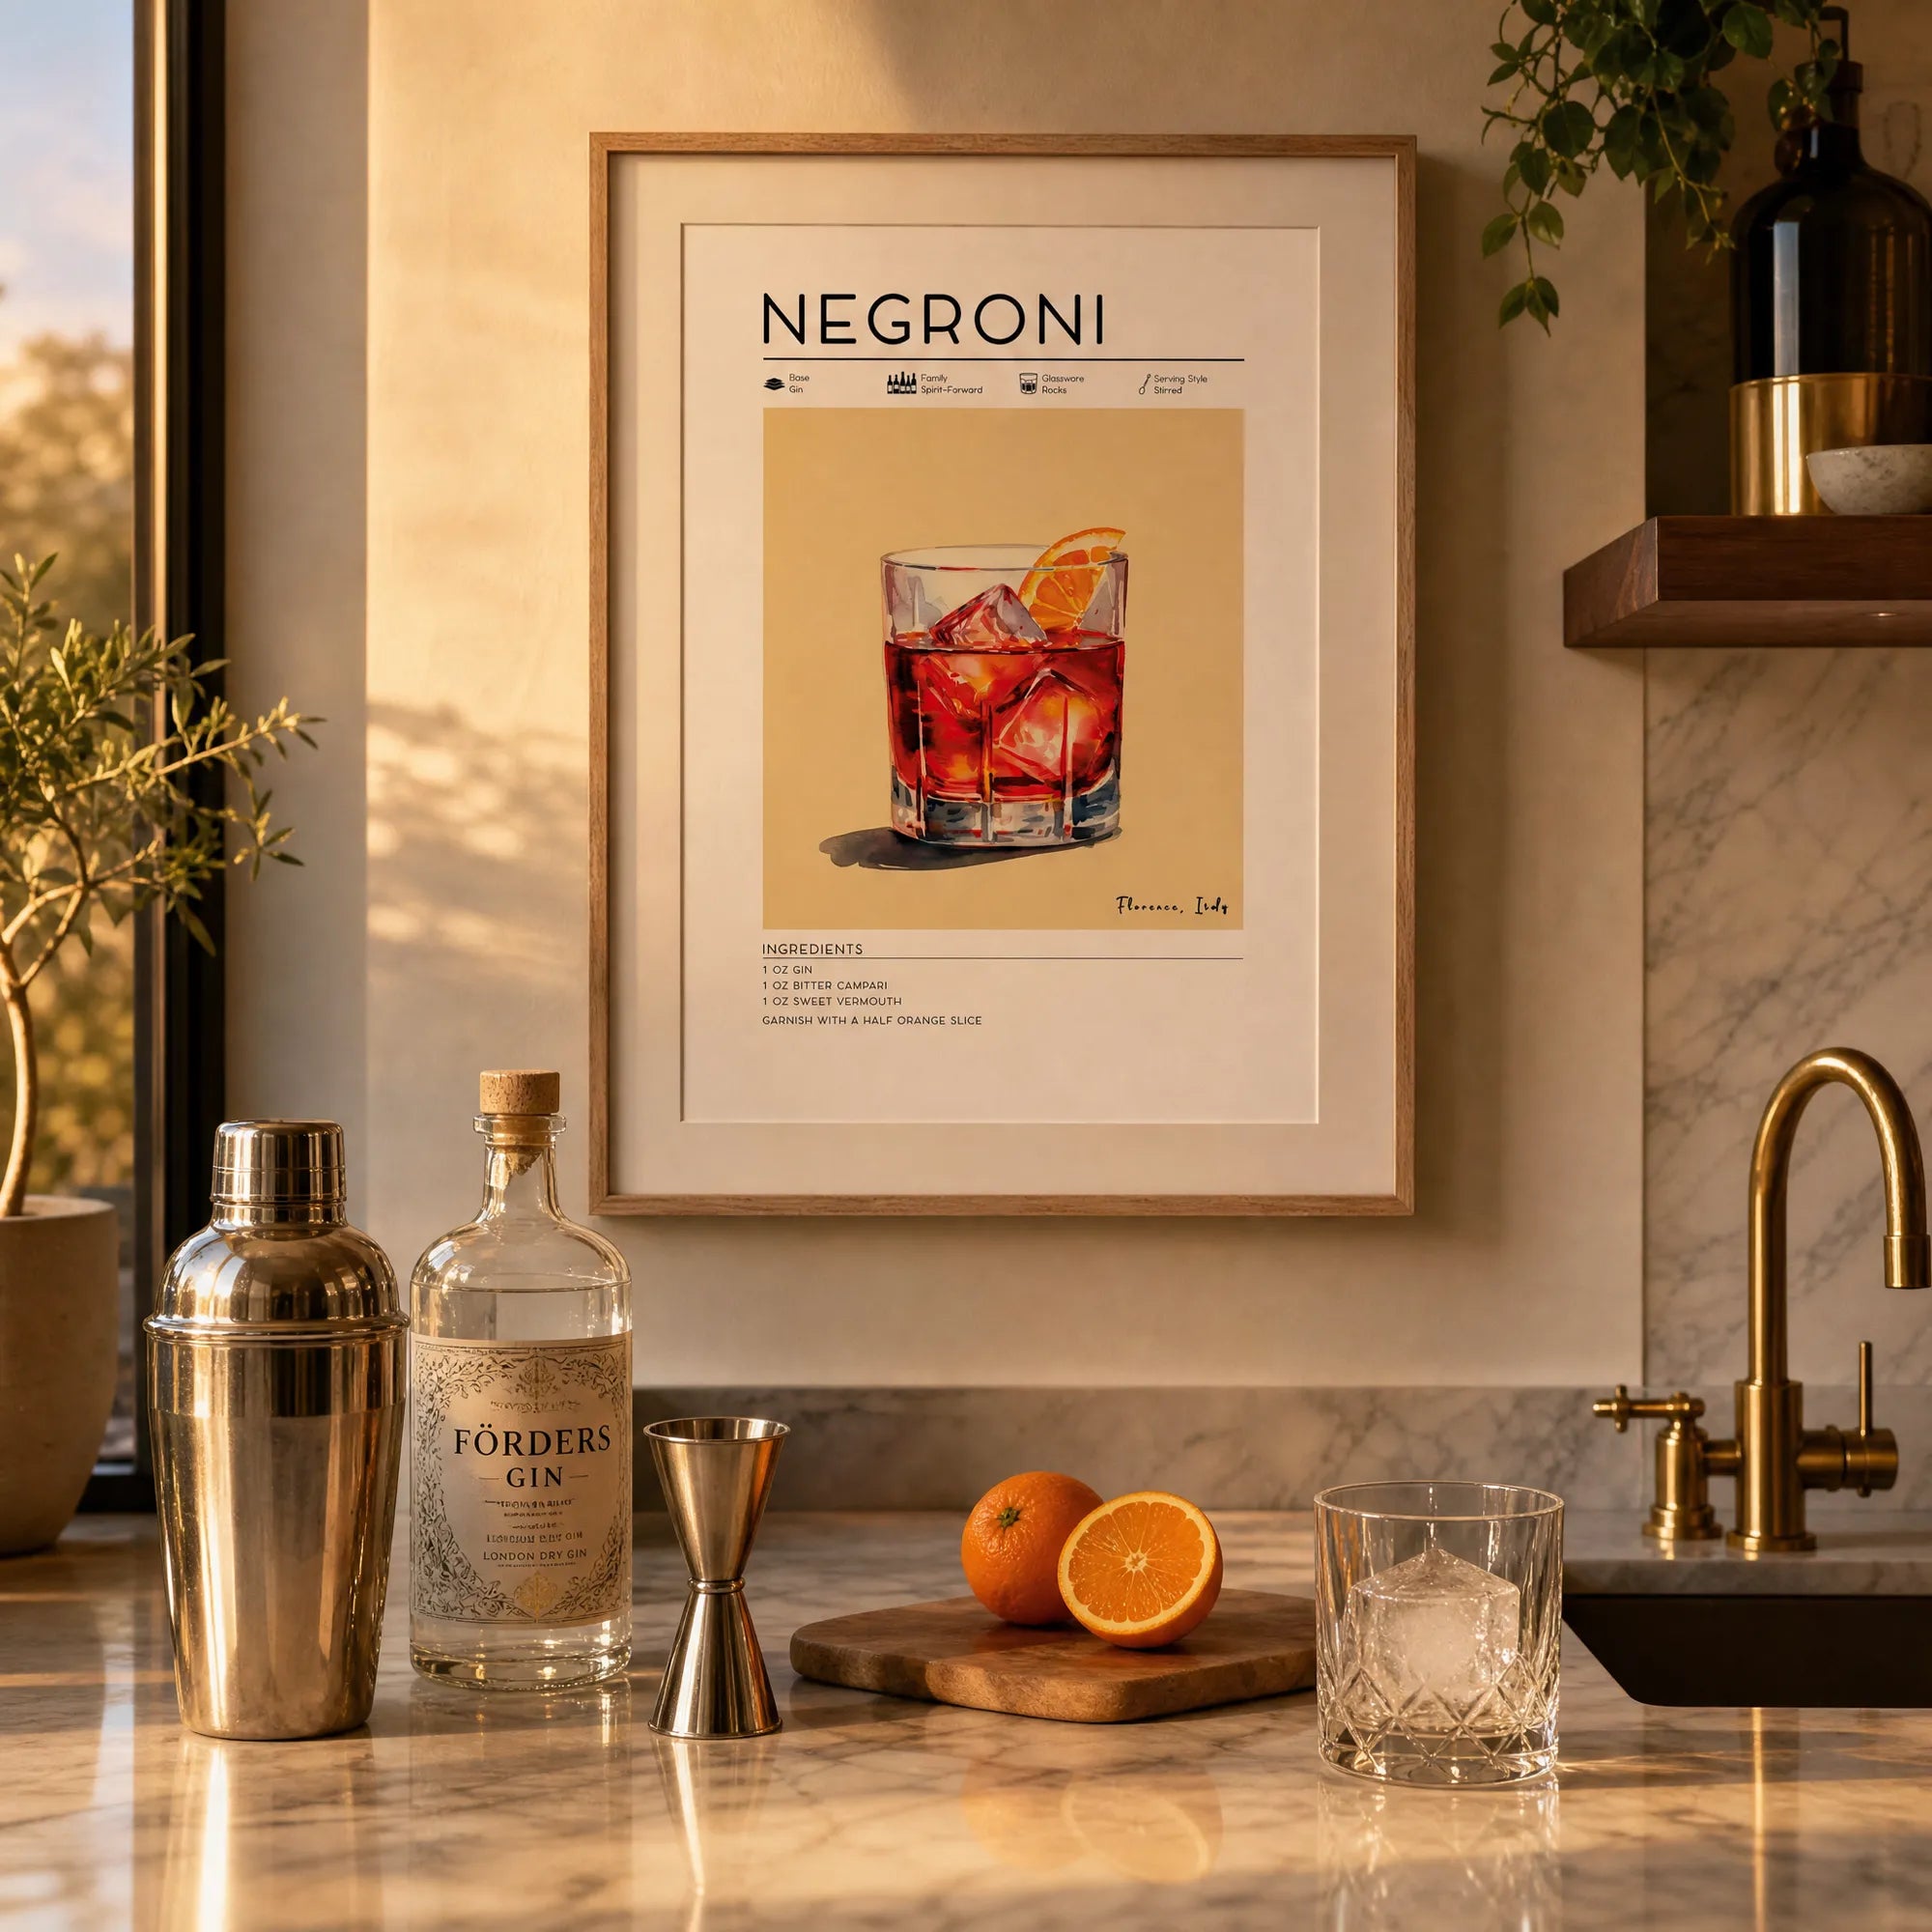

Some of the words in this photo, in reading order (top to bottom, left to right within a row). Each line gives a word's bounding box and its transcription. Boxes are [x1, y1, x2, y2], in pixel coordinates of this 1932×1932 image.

[763, 293, 1103, 346] NEGRONI
[789, 373, 810, 382] Base
[921, 374, 948, 384] Family
[1041, 374, 1085, 384] Glassware
[1154, 375, 1185, 386] Serving
[1187, 375, 1208, 385] Style
[789, 384, 804, 394] Gin
[921, 384, 983, 395] Spirit-Forward
[1042, 385, 1067, 395] Rocks
[1153, 385, 1183, 395] Stirred
[1116, 896, 1184, 915] Florence,
[762, 944, 864, 955] INGREDIENTS
[773, 966, 788, 975] OZ
[792, 966, 812, 975] GIN
[773, 981, 788, 990] OZ
[792, 981, 832, 990] BITTER
[837, 981, 888, 990] CAMPARI
[773, 997, 788, 1006] OZ
[793, 997, 832, 1006] SWEET
[837, 997, 902, 1006] VERMOUTH
[762, 1016, 813, 1025] GARNISH
[817, 1016, 847, 1025] WITH
[851, 1016, 860, 1025] A
[864, 1016, 894, 1025] HALF
[897, 1016, 946, 1025] ORANGE
[951, 1016, 982, 1025] SLICE
[454, 1423, 611, 1457] FÖRDERS
[506, 1466, 563, 1488] GIN
[483, 1550, 536, 1561] LONDON
[539, 1550, 563, 1561] DRY
[567, 1548, 587, 1560] GIN
